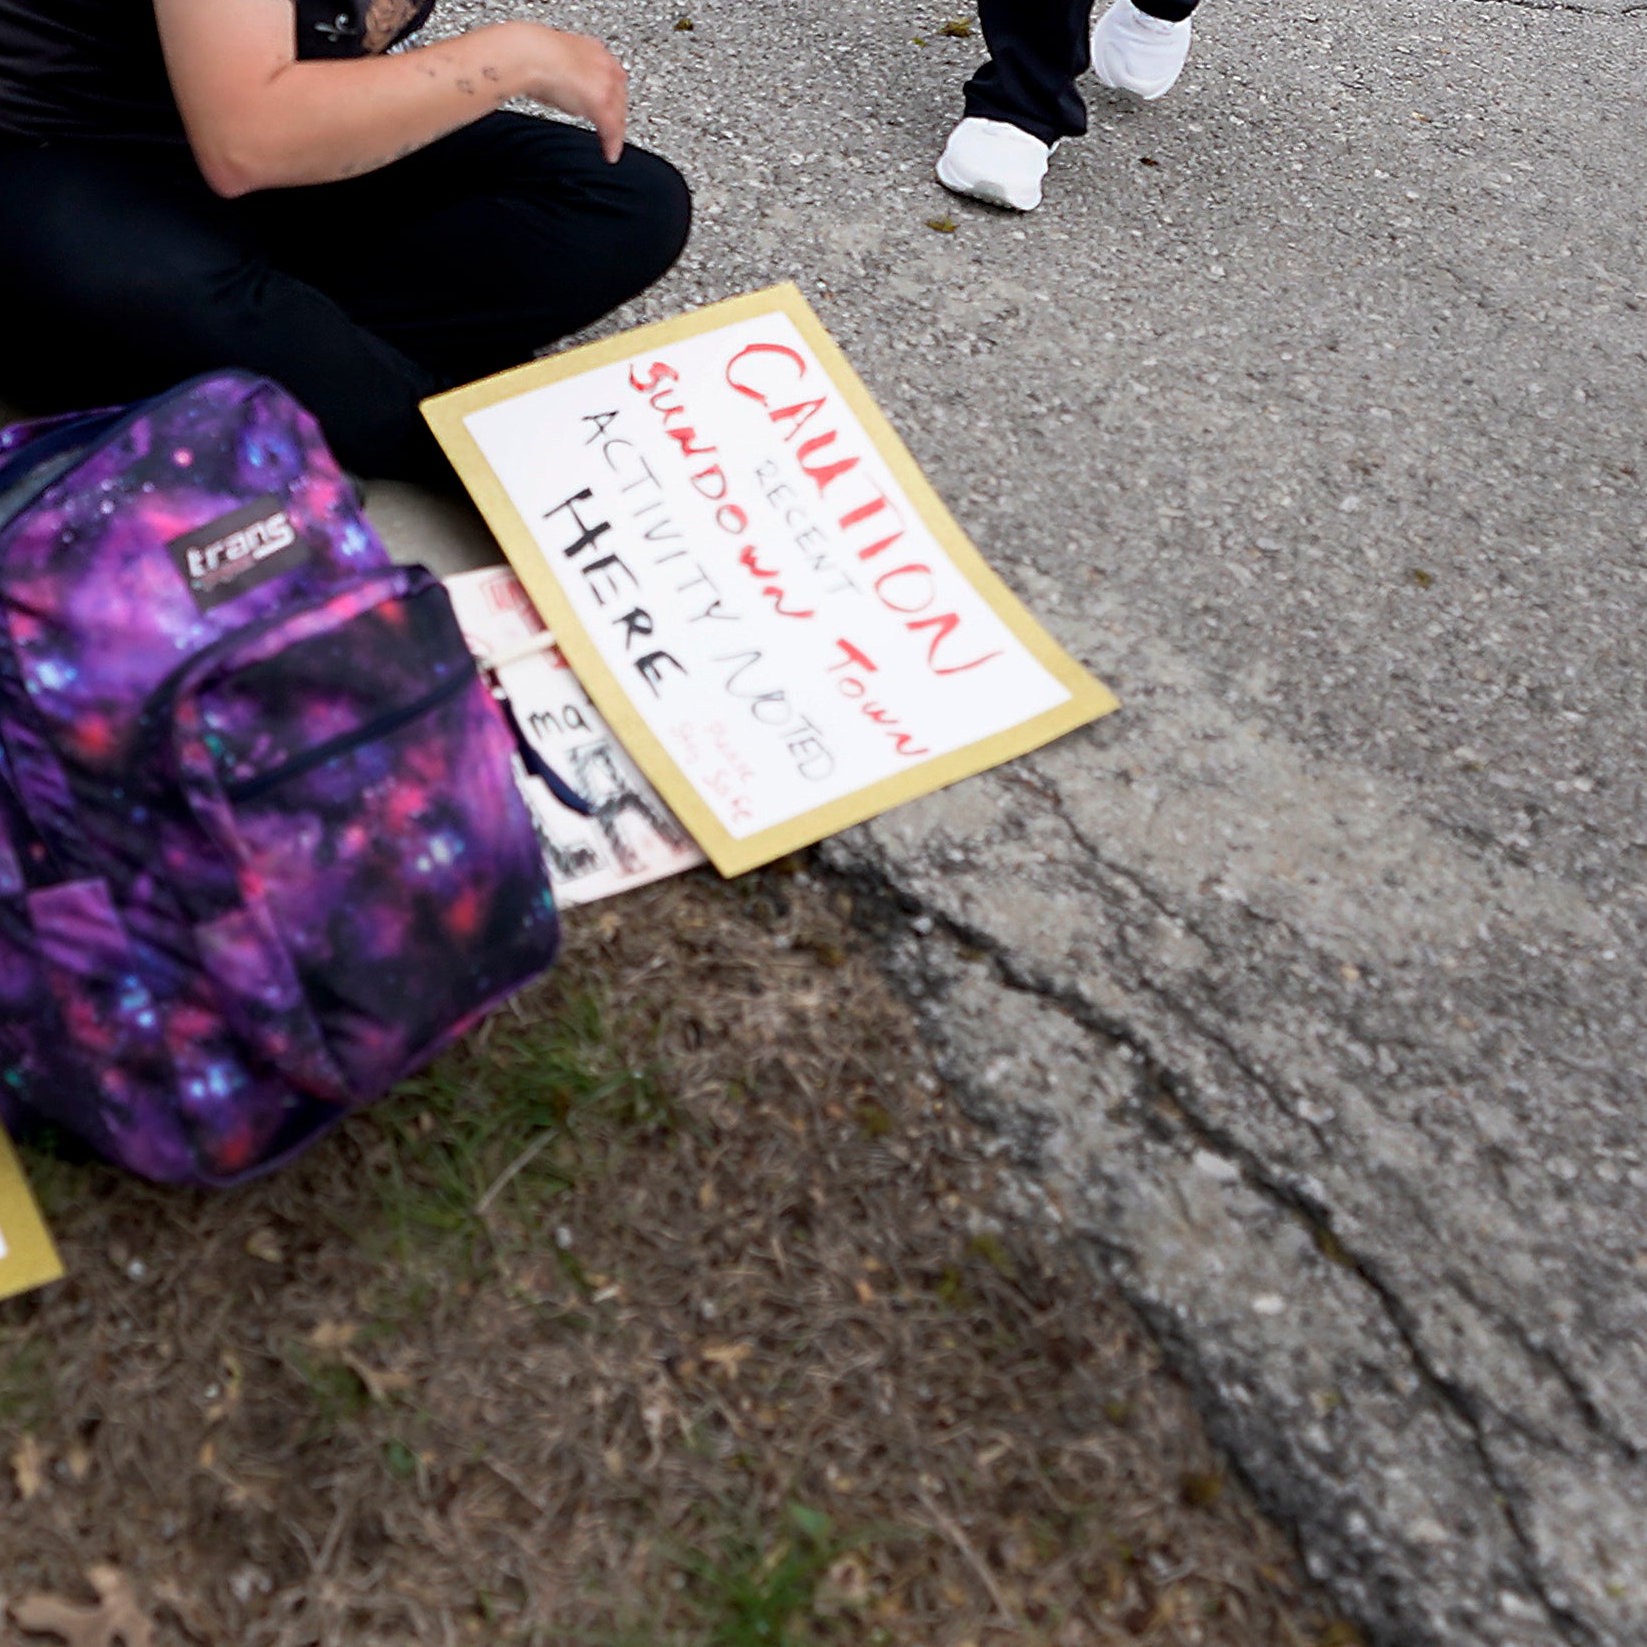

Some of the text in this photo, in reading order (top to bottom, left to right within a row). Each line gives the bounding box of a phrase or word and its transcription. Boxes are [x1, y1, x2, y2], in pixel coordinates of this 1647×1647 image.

[541, 486, 690, 699] HERE
[580, 409, 741, 623] ACTIVITY
[712, 651, 836, 782] NOTED
[629, 361, 816, 619] SUNDOWN
[726, 343, 1005, 676] CAUTION
[755, 458, 862, 597] RECENT
